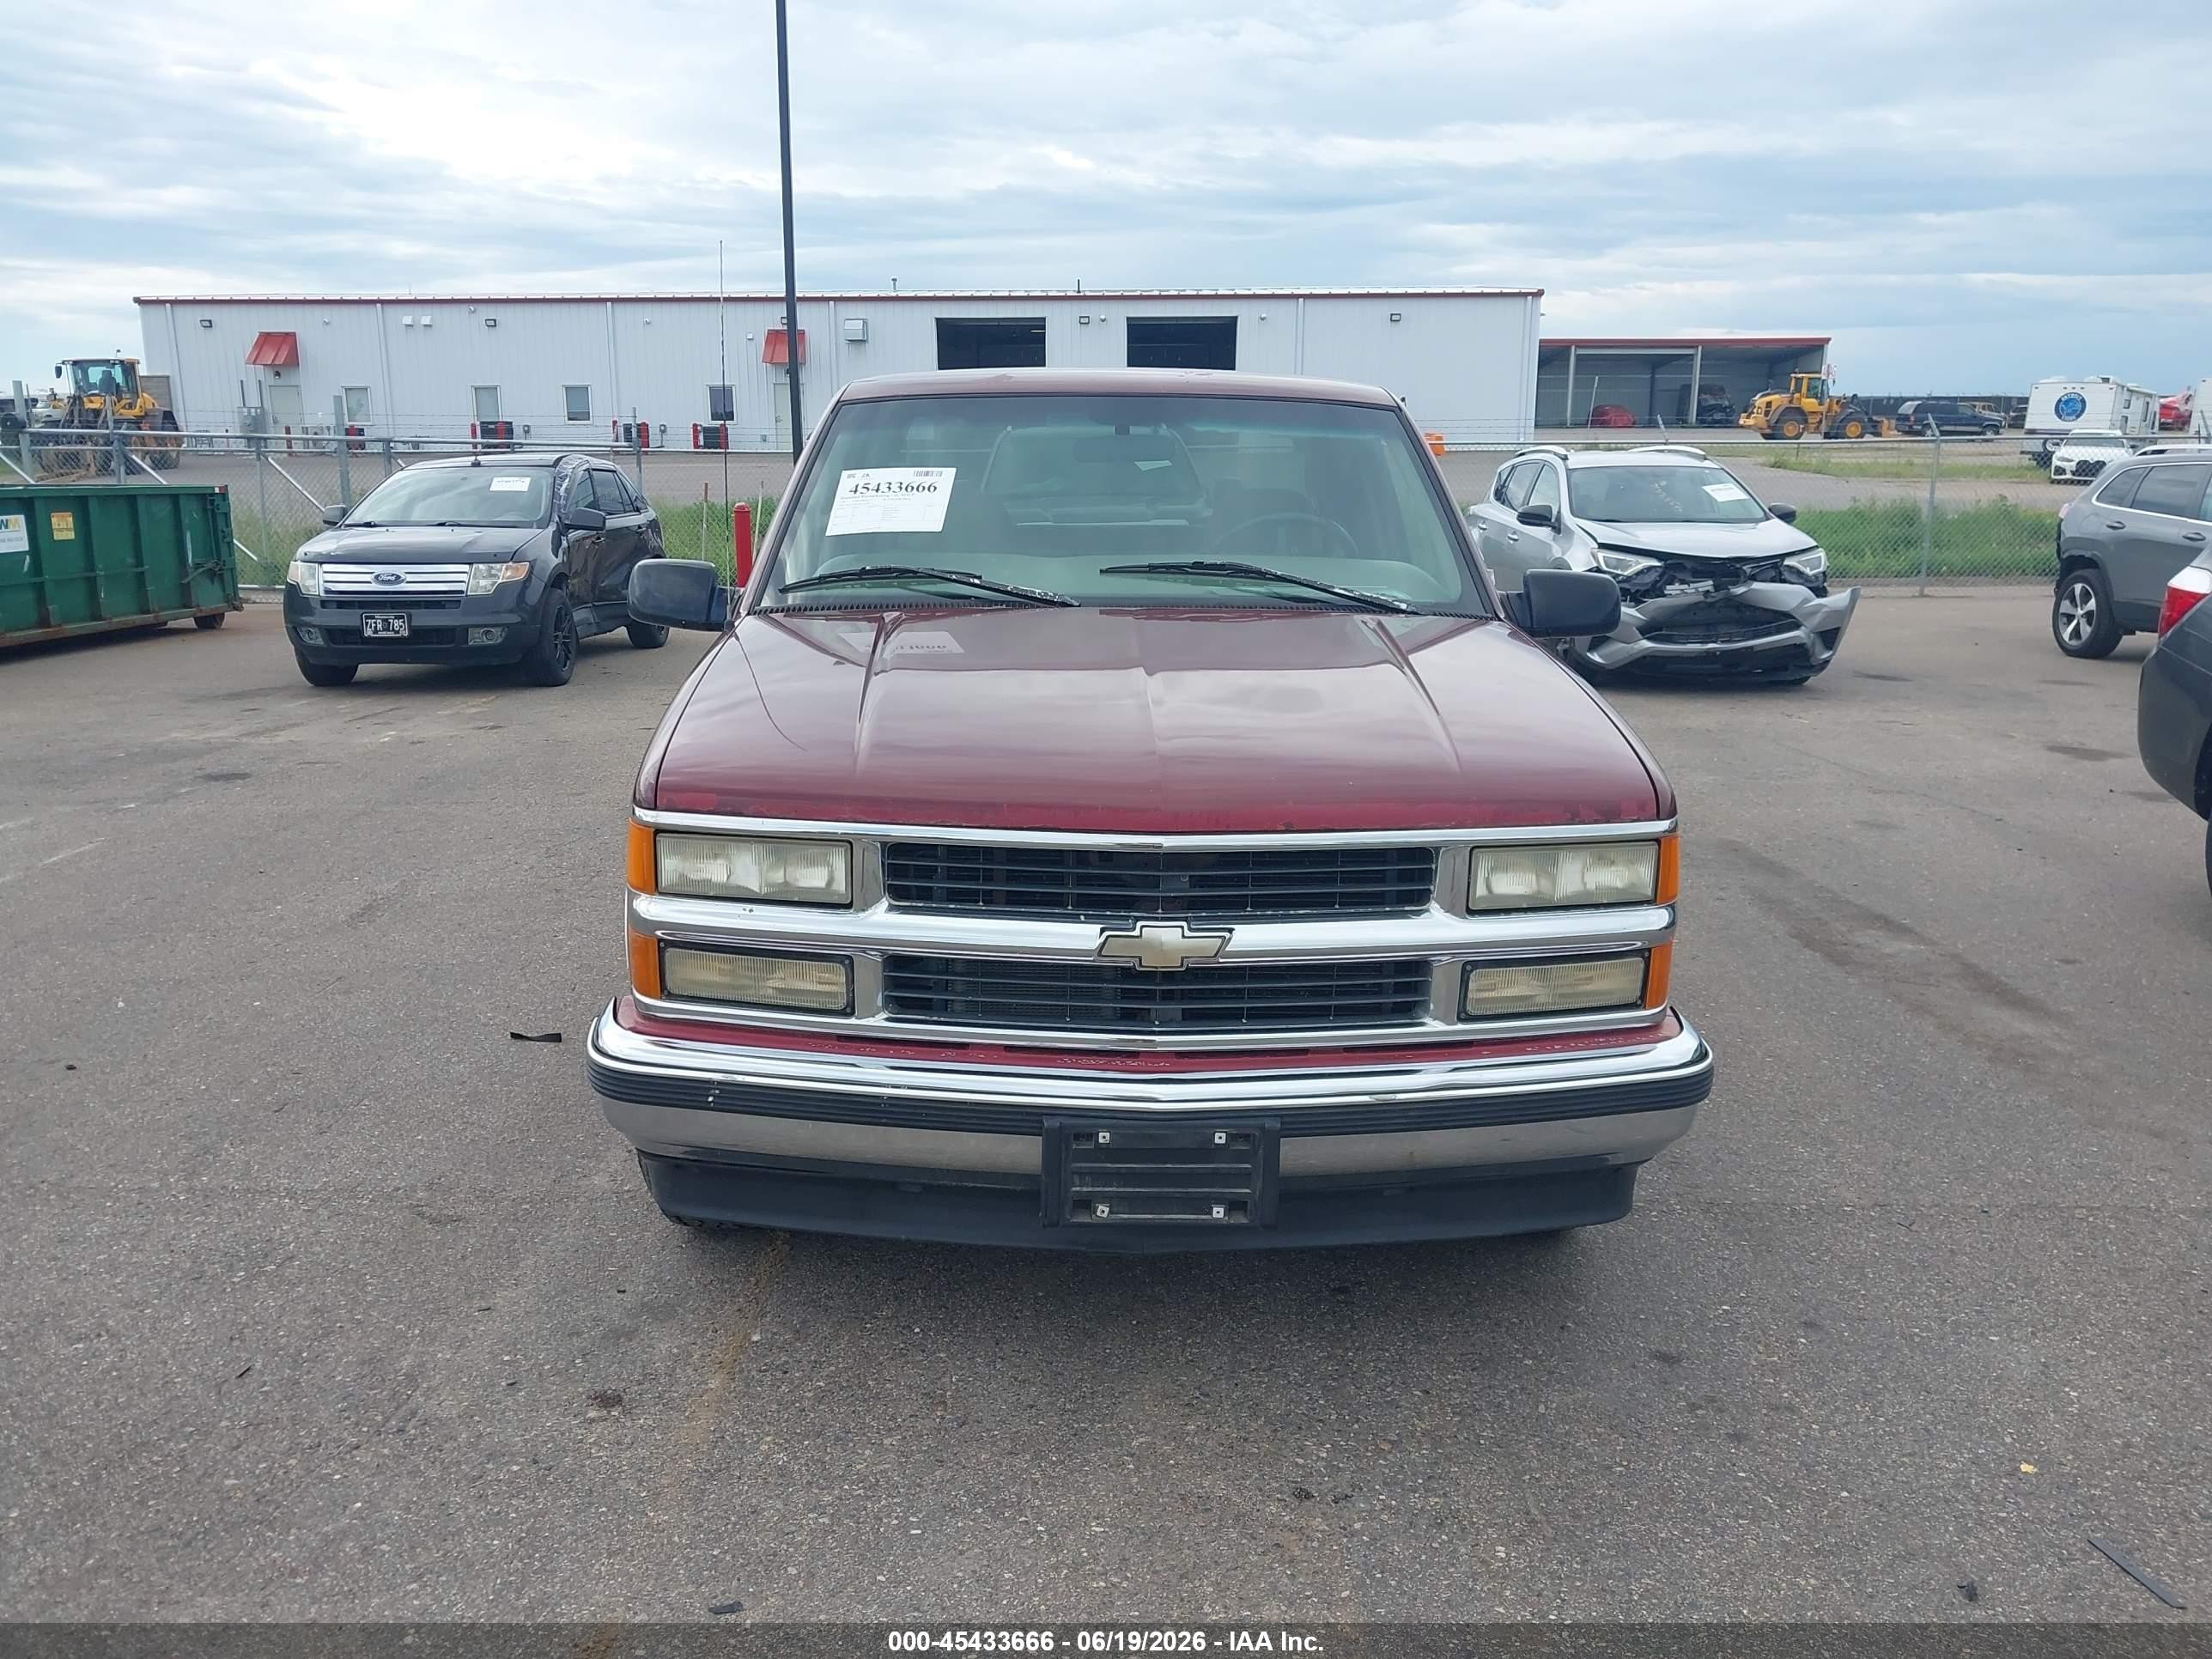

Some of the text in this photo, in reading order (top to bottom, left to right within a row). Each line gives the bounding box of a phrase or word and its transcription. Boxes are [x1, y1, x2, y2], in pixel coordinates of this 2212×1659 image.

[848, 481, 938, 495] 45433666
[365, 619, 404, 631] ZFR 785
